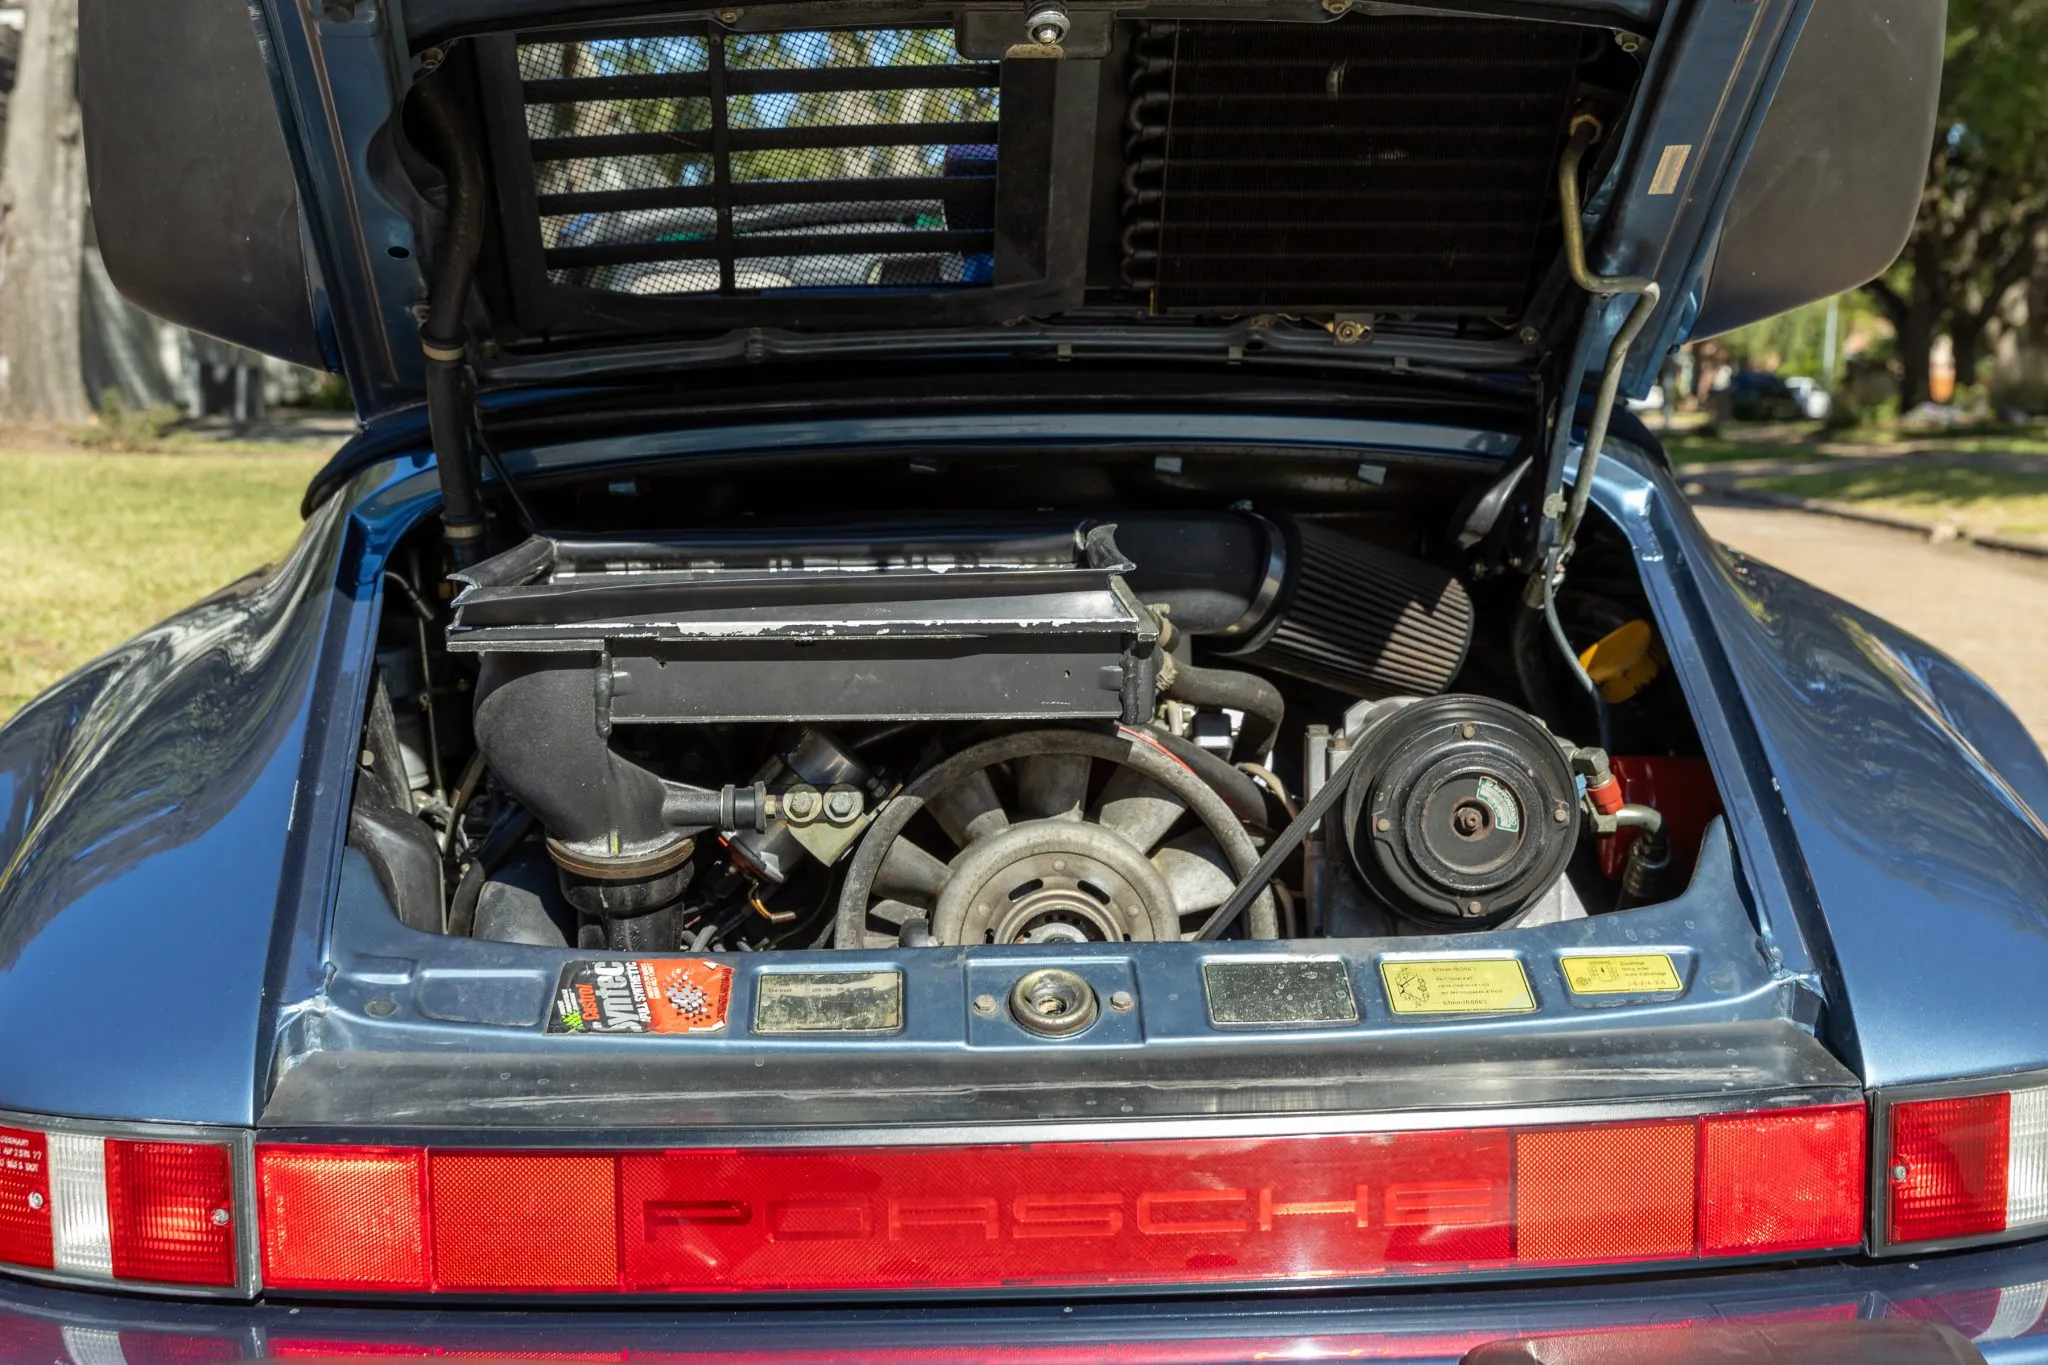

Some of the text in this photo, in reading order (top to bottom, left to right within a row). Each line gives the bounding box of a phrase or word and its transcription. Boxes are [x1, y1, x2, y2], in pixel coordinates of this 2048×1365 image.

[575, 983, 600, 1021] Castrol
[592, 961, 643, 1032] Syntec
[625, 961, 647, 1002] SYNTHETIC
[644, 1180, 1493, 1243] PORSCHE
